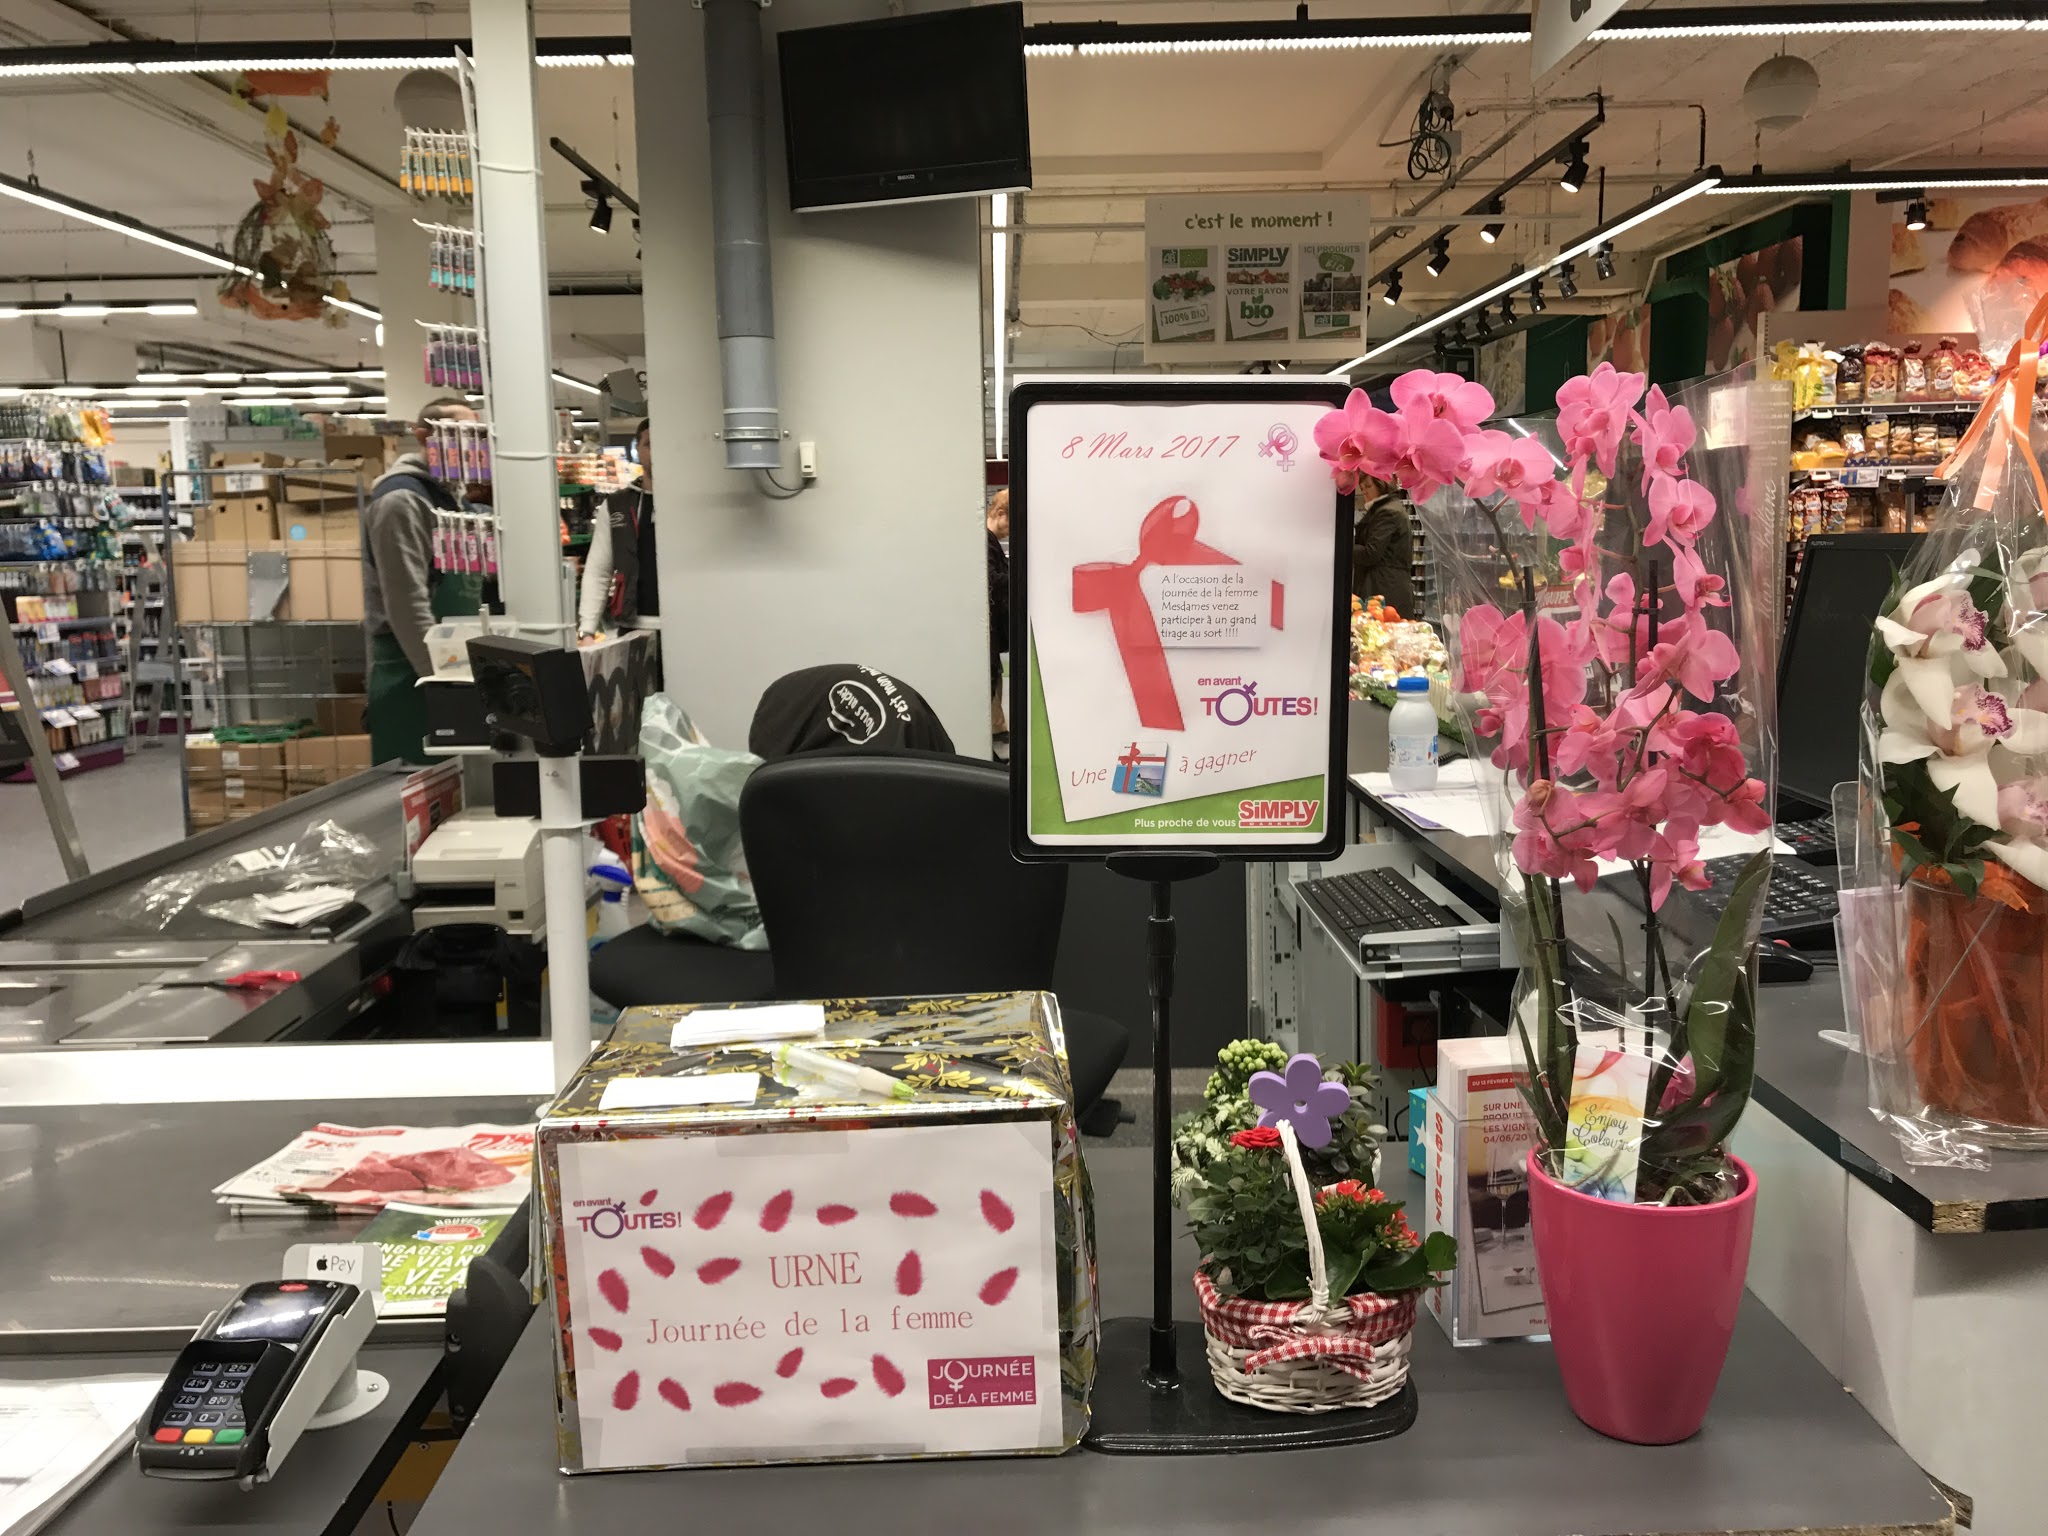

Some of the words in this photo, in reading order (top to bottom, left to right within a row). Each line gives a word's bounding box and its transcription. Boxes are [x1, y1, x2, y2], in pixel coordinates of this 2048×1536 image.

[1185, 213, 1224, 230] c'est
[1230, 213, 1244, 229] le
[1251, 211, 1323, 228] moment
[1317, 244, 1360, 253] PRODUITS
[1227, 288, 1255, 296] VOTRE
[1258, 287, 1289, 295] RAYON
[1164, 311, 1190, 325] 100%
[1191, 308, 1206, 320] BIO
[1241, 301, 1274, 319] bio
[1061, 435, 1084, 459] 8
[1087, 431, 1154, 459] Mars
[1161, 435, 1241, 459] 2017
[1161, 574, 1171, 584] A
[1173, 572, 1219, 584] l'occasion
[1221, 573, 1233, 584] de
[1236, 572, 1244, 584] la
[1161, 588, 1198, 600] journée
[1200, 587, 1212, 598] de
[1214, 586, 1222, 597] la
[1225, 585, 1259, 597] femme
[1161, 601, 1210, 612] Mesdames
[1212, 603, 1239, 611] venez
[1161, 614, 1205, 627] participer
[1206, 614, 1212, 625] à
[1214, 616, 1228, 625] un
[1230, 614, 1257, 628] grand
[1161, 628, 1188, 641] tirage
[1189, 630, 1201, 638] au
[1203, 628, 1222, 638] sort
[876, 675, 897, 696] mon
[1197, 677, 1212, 686] en
[1213, 675, 1242, 686] avant
[836, 685, 858, 709] aider
[1200, 682, 1318, 726] TOUTES!
[854, 705, 875, 737] Vous
[1071, 767, 1107, 787] Une
[1178, 757, 1189, 773] à
[1193, 748, 1257, 777] gagner
[1134, 818, 1156, 828] Plus
[1157, 818, 1194, 830] proche
[1196, 817, 1210, 828] de
[1212, 819, 1236, 828] vous
[1483, 1103, 1501, 1112] SUR
[1585, 1104, 1629, 1136] Enjoy
[1483, 1125, 1500, 1133] LES
[573, 1199, 586, 1208] en
[587, 1197, 612, 1207] avant
[577, 1201, 683, 1239] TOUTES!
[330, 1254, 356, 1274] Pay
[768, 1251, 862, 1289] URNE
[646, 1316, 766, 1345] Journée
[784, 1311, 818, 1336] de
[841, 1308, 870, 1333] la
[891, 1305, 974, 1330] femme
[932, 1360, 1033, 1392] JOURNÉE
[208, 1396, 218, 1405] 8
[933, 1394, 954, 1406] DE
[958, 1392, 977, 1404] LA
[981, 1390, 1034, 1404] FEMME
